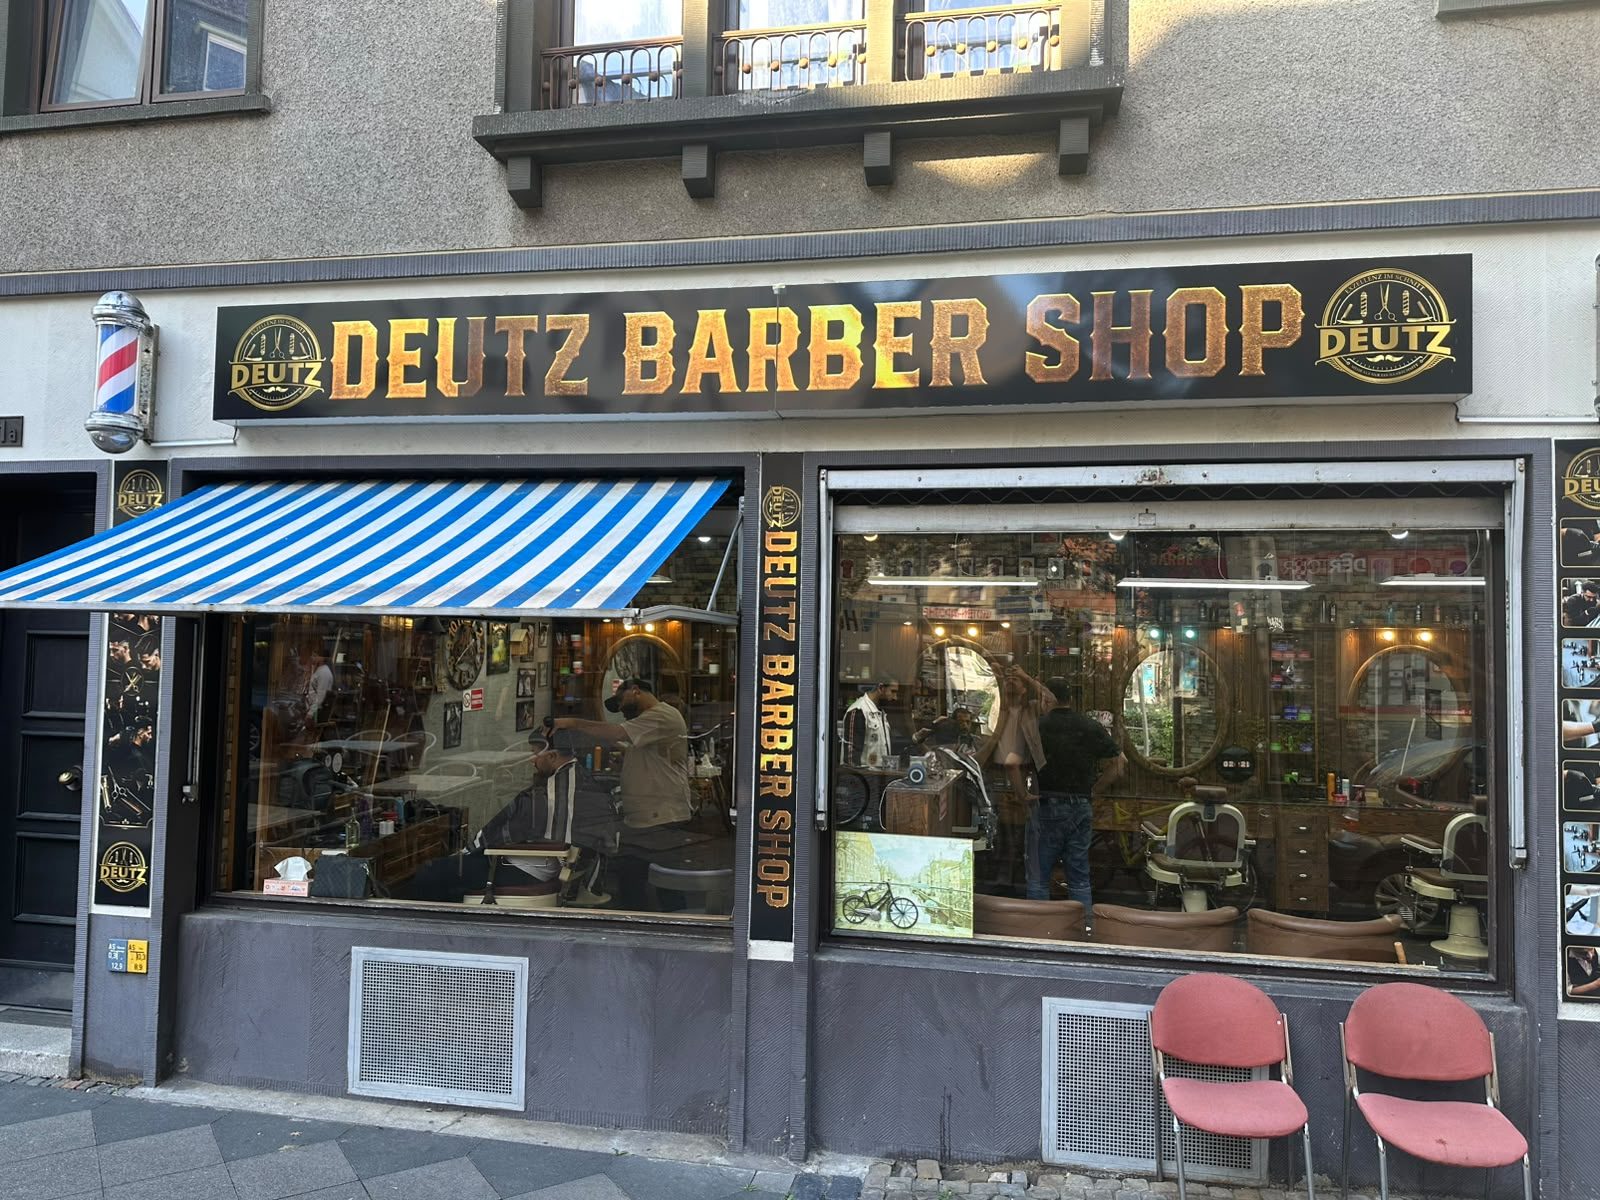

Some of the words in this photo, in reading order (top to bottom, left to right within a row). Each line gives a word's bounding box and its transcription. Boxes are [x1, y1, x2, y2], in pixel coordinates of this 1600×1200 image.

[1394, 274, 1426, 291] SCHNITT
[329, 313, 590, 400] DEUTZ
[622, 297, 990, 395] BARBER
[1025, 283, 1306, 383] SHOP
[1319, 324, 1451, 359] DEUTZ
[231, 361, 322, 390] DEUTZ
[119, 493, 163, 507] DEUTZ
[770, 486, 782, 528] DEUTZ
[763, 530, 798, 642] DEUTZ
[759, 654, 796, 797] BARBER
[100, 866, 147, 882] DEUTZ
[757, 809, 792, 908] SHOP
